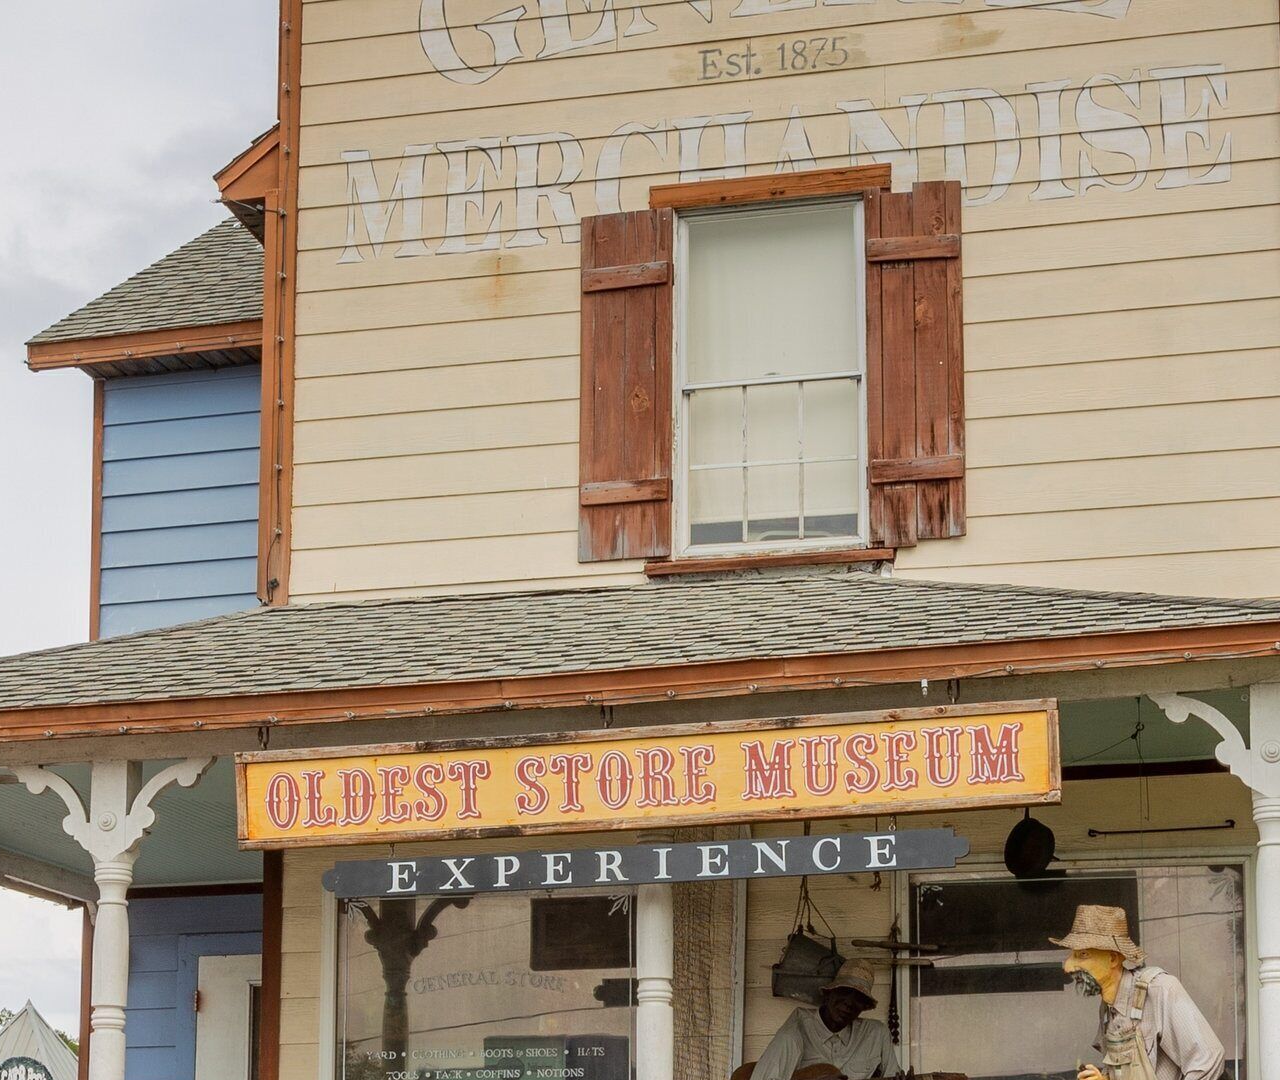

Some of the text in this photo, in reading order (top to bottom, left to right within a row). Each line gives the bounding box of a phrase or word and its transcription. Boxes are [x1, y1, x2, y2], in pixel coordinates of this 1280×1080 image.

[697, 48, 762, 82] Est.
[776, 35, 850, 71] 1875
[337, 63, 1233, 264] MERCHANDISE
[264, 722, 1025, 831] OLDEST STORE MUSEUM
[387, 833, 901, 894] EXPERIENCE
[413, 970, 499, 995] GENERAL
[366, 1050, 397, 1060] YARD
[480, 1048, 514, 1059] BOOTS
[525, 1047, 559, 1058] SHOES
[576, 1046, 606, 1057] HATS
[385, 1067, 585, 1080] TOOLS TACK COFFINS NOTIONS
